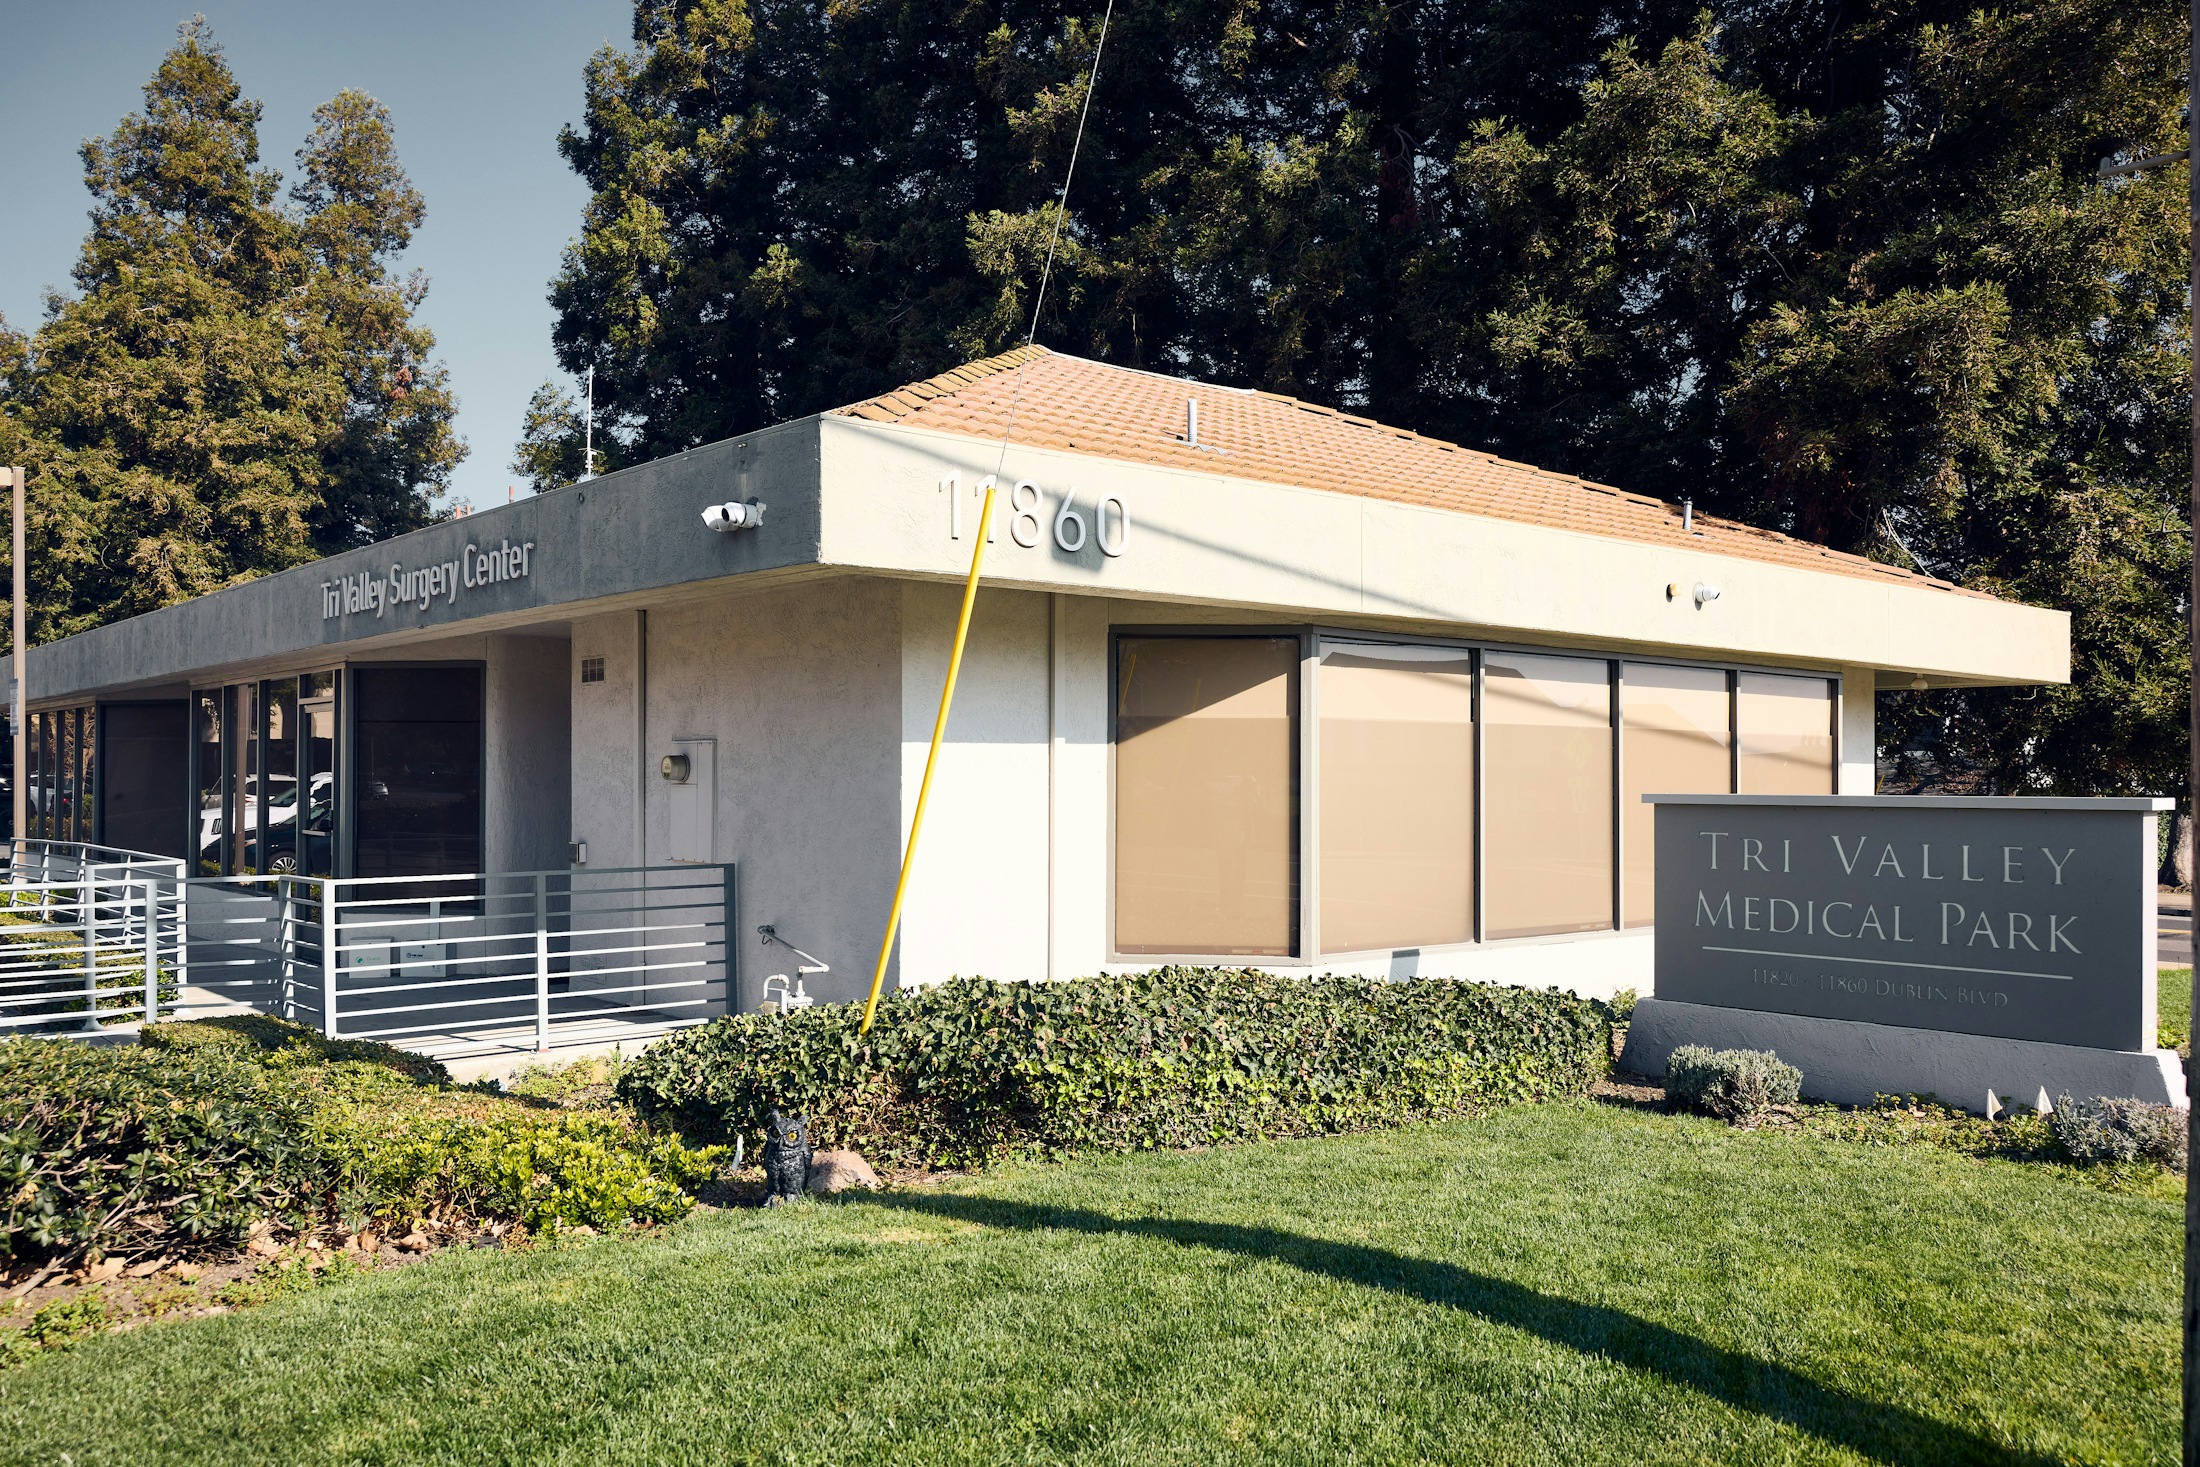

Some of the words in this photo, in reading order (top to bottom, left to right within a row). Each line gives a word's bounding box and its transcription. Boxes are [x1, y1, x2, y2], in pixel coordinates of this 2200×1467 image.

[938, 469, 1130, 557] 11860
[321, 579, 340, 619] Tri
[342, 571, 387, 619] Valley
[390, 560, 460, 611] Surgery
[464, 540, 535, 588] Center
[1699, 832, 1791, 873] TRI
[1830, 835, 2076, 885] VALLEY
[1695, 889, 1914, 942] MEDICAL
[1938, 901, 2082, 954] PARK
[1752, 968, 1798, 987] 11820
[1818, 974, 1868, 993] 11860
[1876, 979, 1948, 1001] DUBLIN
[1957, 986, 2008, 1007] BLVD
